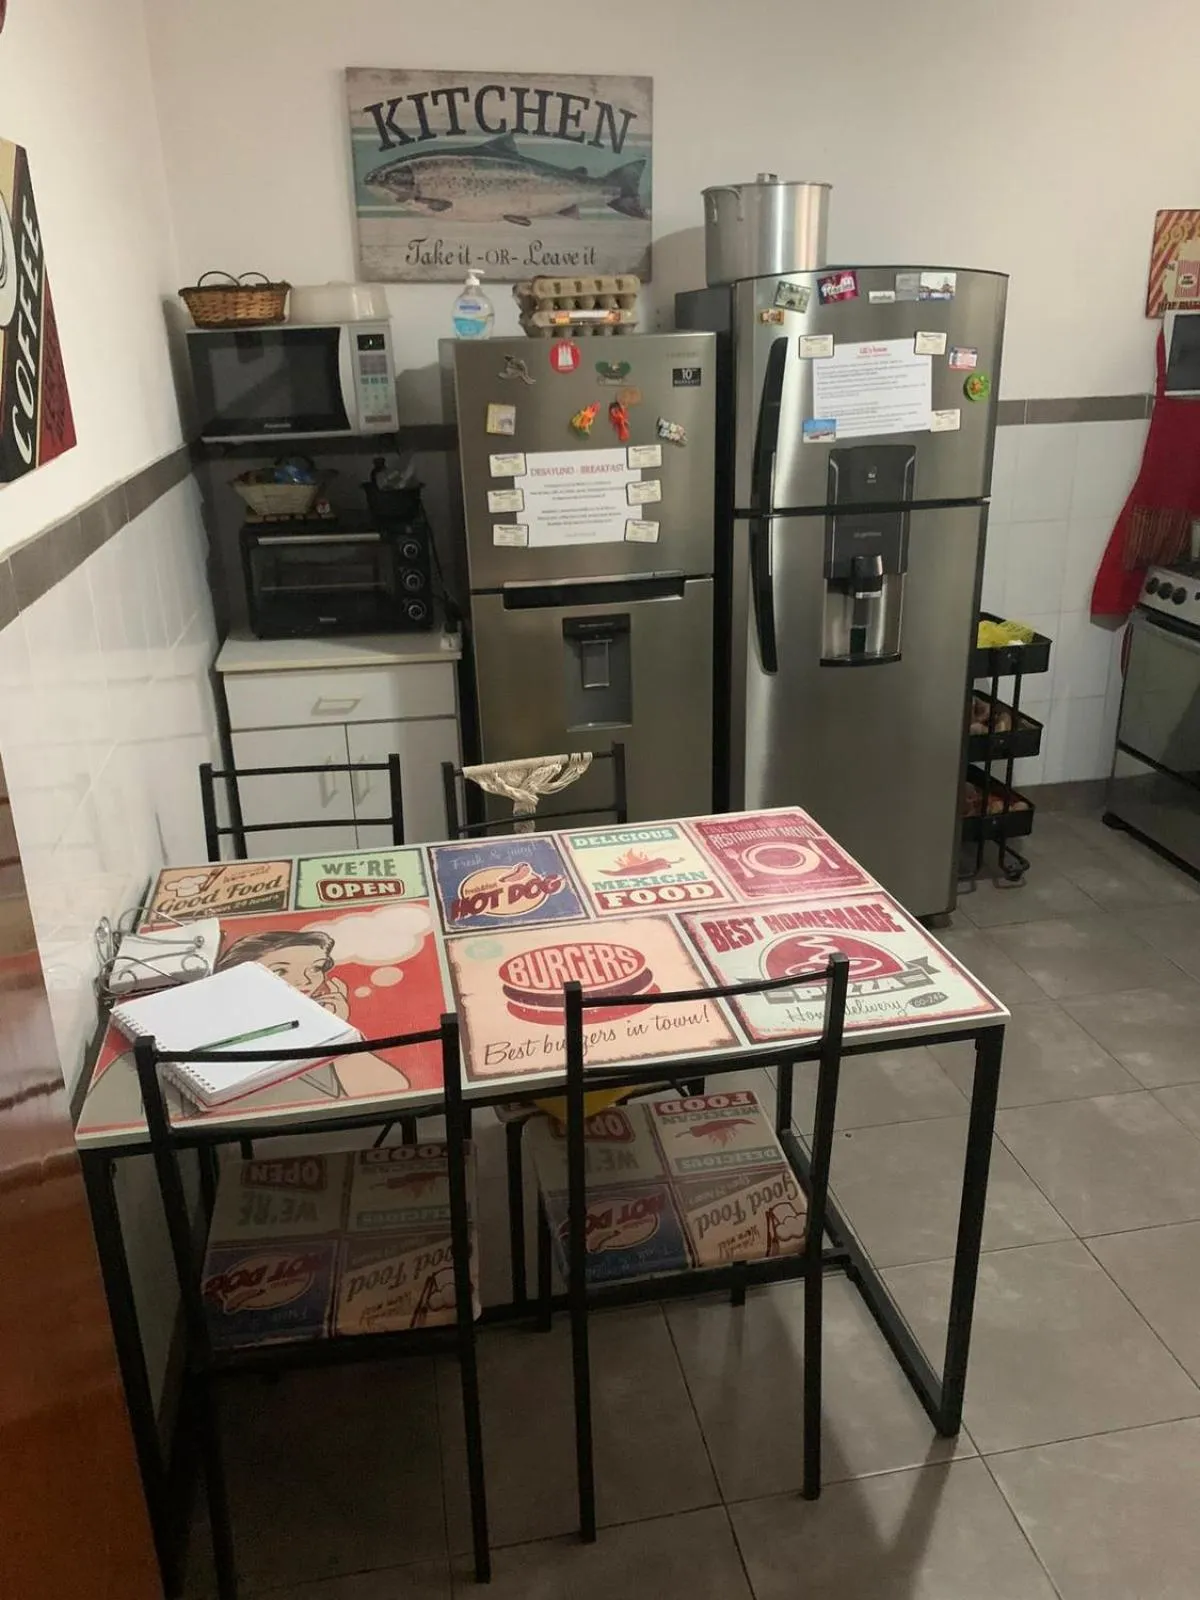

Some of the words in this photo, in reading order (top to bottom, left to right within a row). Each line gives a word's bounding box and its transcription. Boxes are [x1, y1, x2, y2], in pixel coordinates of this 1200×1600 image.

[363, 85, 638, 153] KITCHEN
[405, 238, 454, 266] Take
[457, 244, 472, 266] it
[523, 240, 577, 266] Leave
[582, 246, 597, 266] it
[12, 195, 39, 465] COFFEE
[580, 463, 625, 474] BREAKFAST
[574, 829, 675, 848] DELICIOUS
[707, 828, 779, 849] RESTAURANT
[322, 858, 398, 876] WE'RE
[592, 871, 706, 891] MEXICAN
[157, 889, 221, 914] Good
[226, 875, 283, 899] Food
[325, 881, 396, 899] OPEN
[452, 888, 504, 919] HOT
[508, 874, 562, 905] DOG
[603, 885, 715, 907] FOOD
[700, 917, 763, 953] BEST
[761, 904, 905, 933] HOMEMADE
[507, 945, 640, 990] BURGERS
[484, 1042, 536, 1066] Best
[627, 1020, 648, 1037] in
[655, 1004, 710, 1030] town!
[661, 1092, 751, 1113] FOOD
[248, 1160, 319, 1186] OPEN
[681, 1149, 779, 1170] DELICIOUS
[747, 1171, 798, 1216] Good
[695, 1199, 747, 1240] Food
[414, 1247, 453, 1280] ood
[346, 1262, 407, 1302] Food
